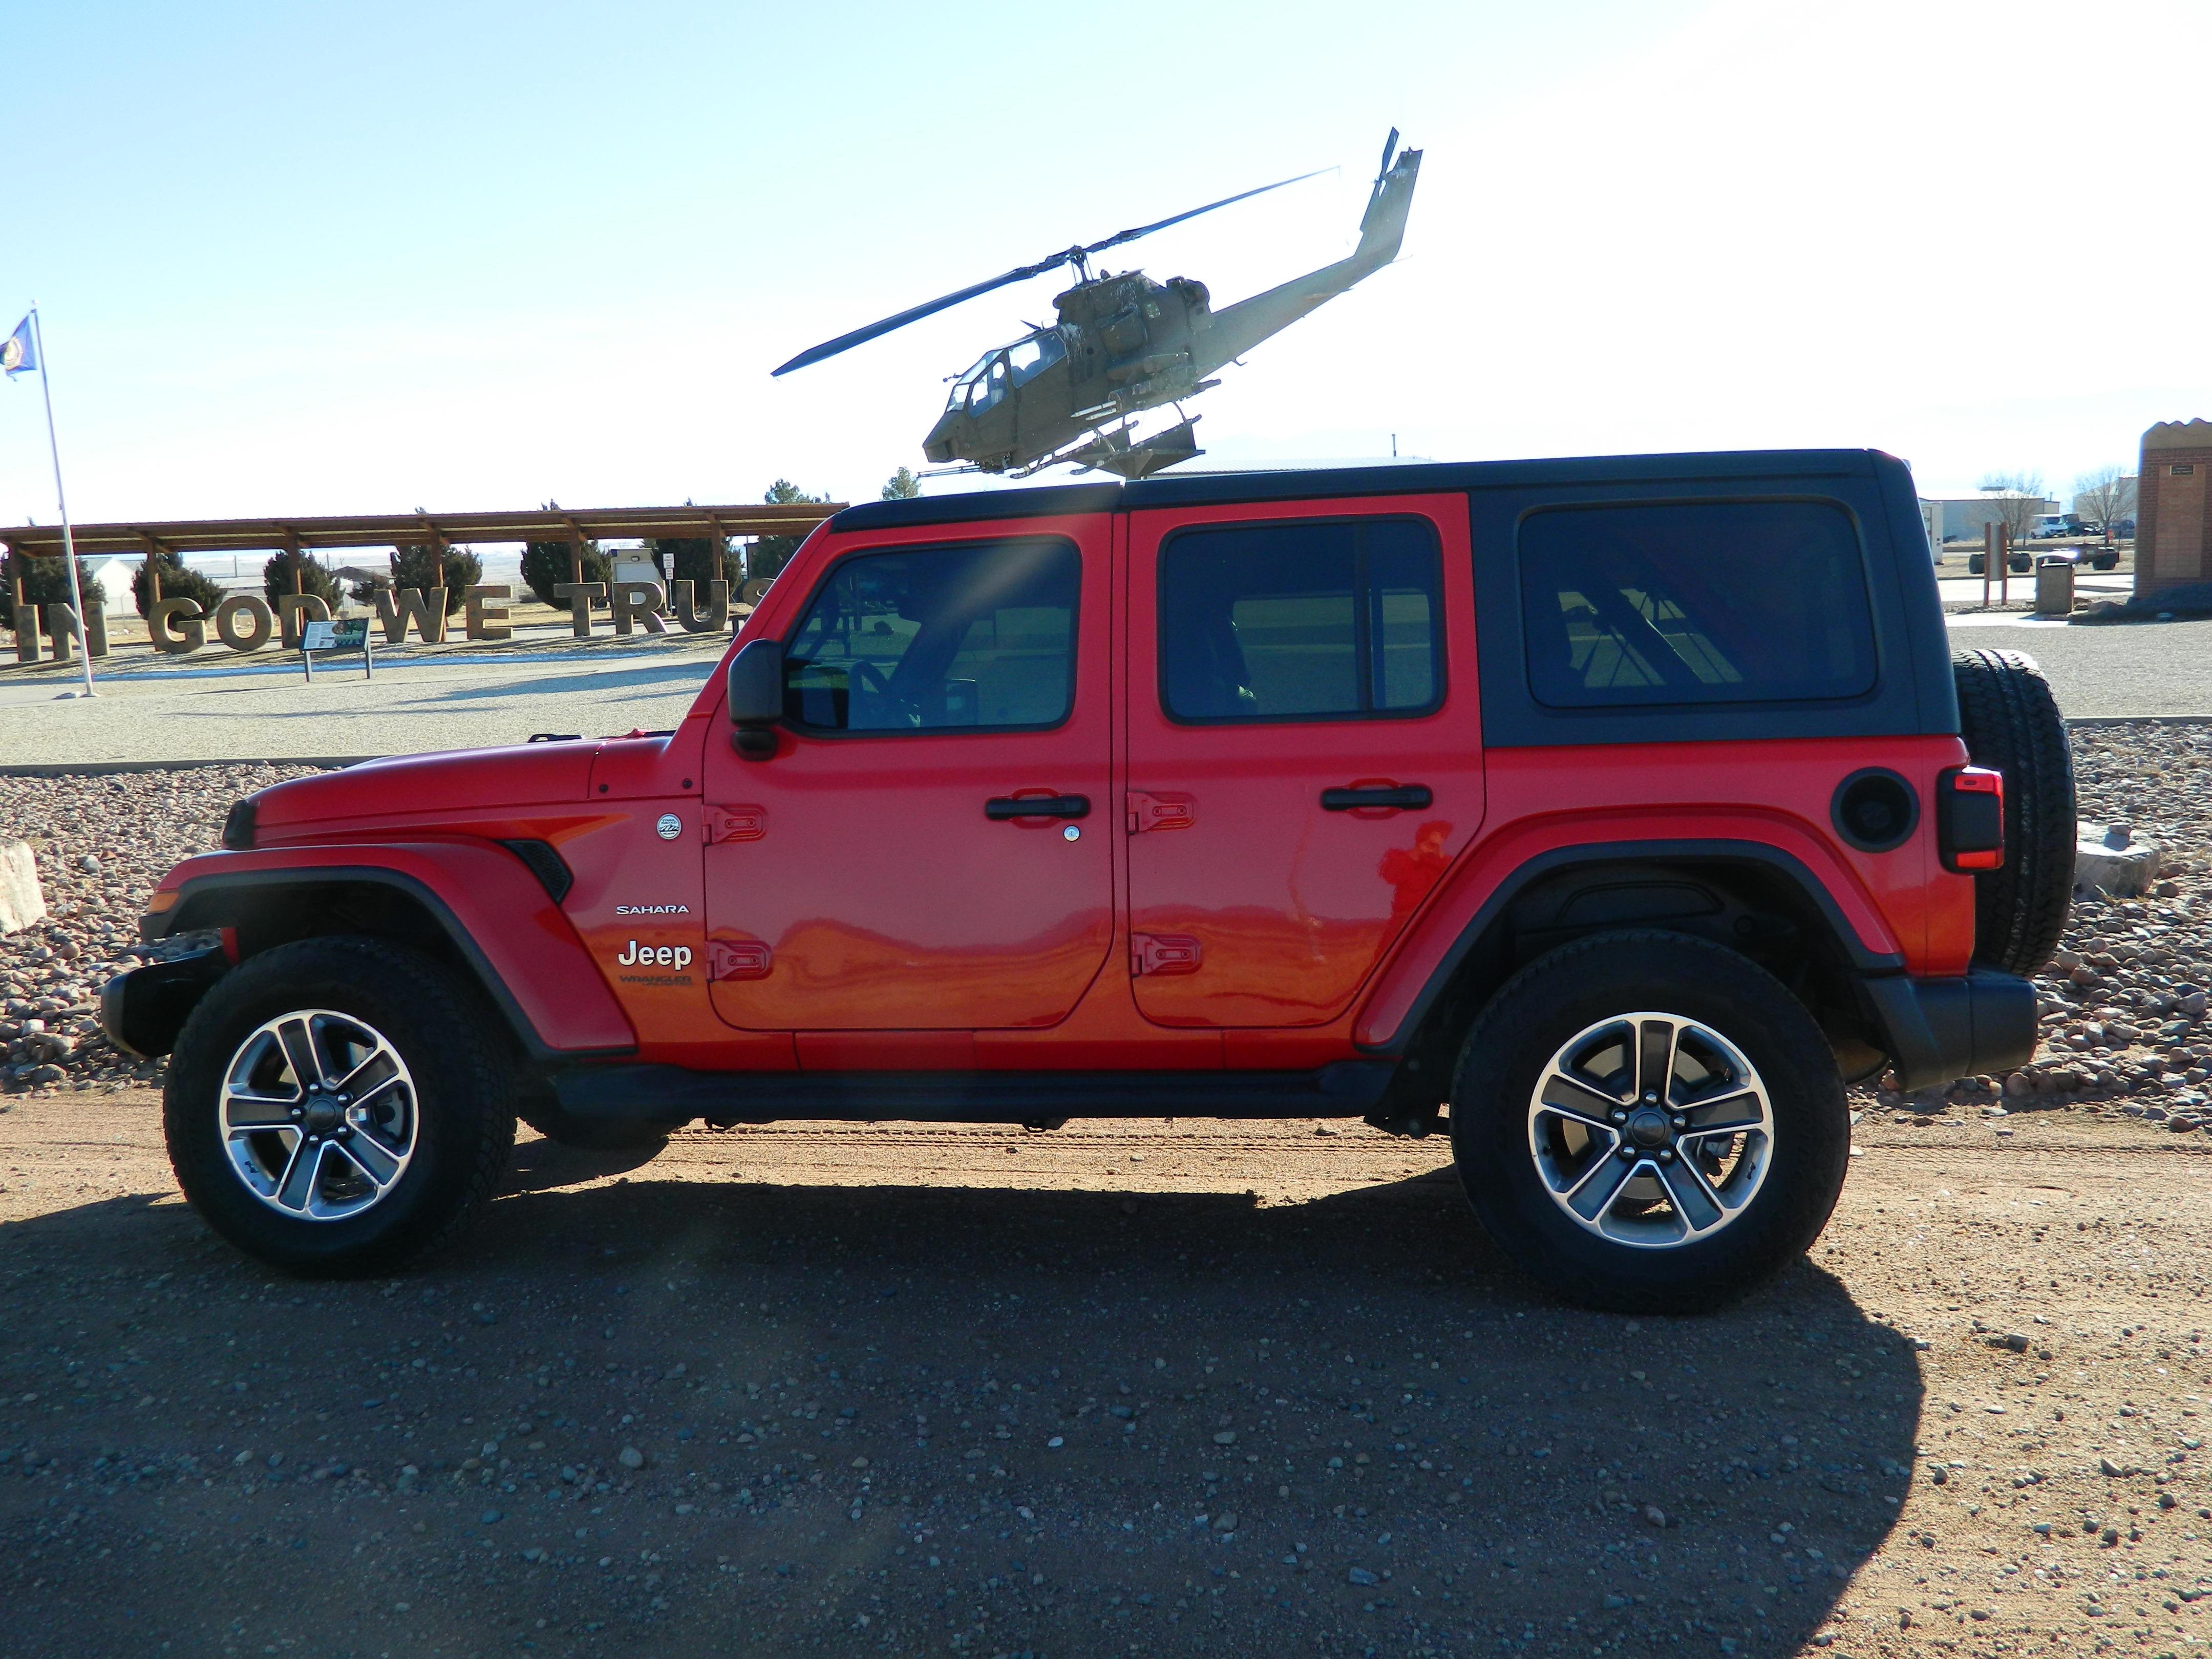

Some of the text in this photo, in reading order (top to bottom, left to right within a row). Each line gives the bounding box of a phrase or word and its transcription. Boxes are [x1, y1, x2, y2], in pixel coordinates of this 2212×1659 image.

[16, 601, 110, 662] IN
[148, 594, 332, 653] GOD
[374, 585, 513, 643] WE
[616, 905, 690, 914] SAHARA
[618, 940, 692, 970] Jeep
